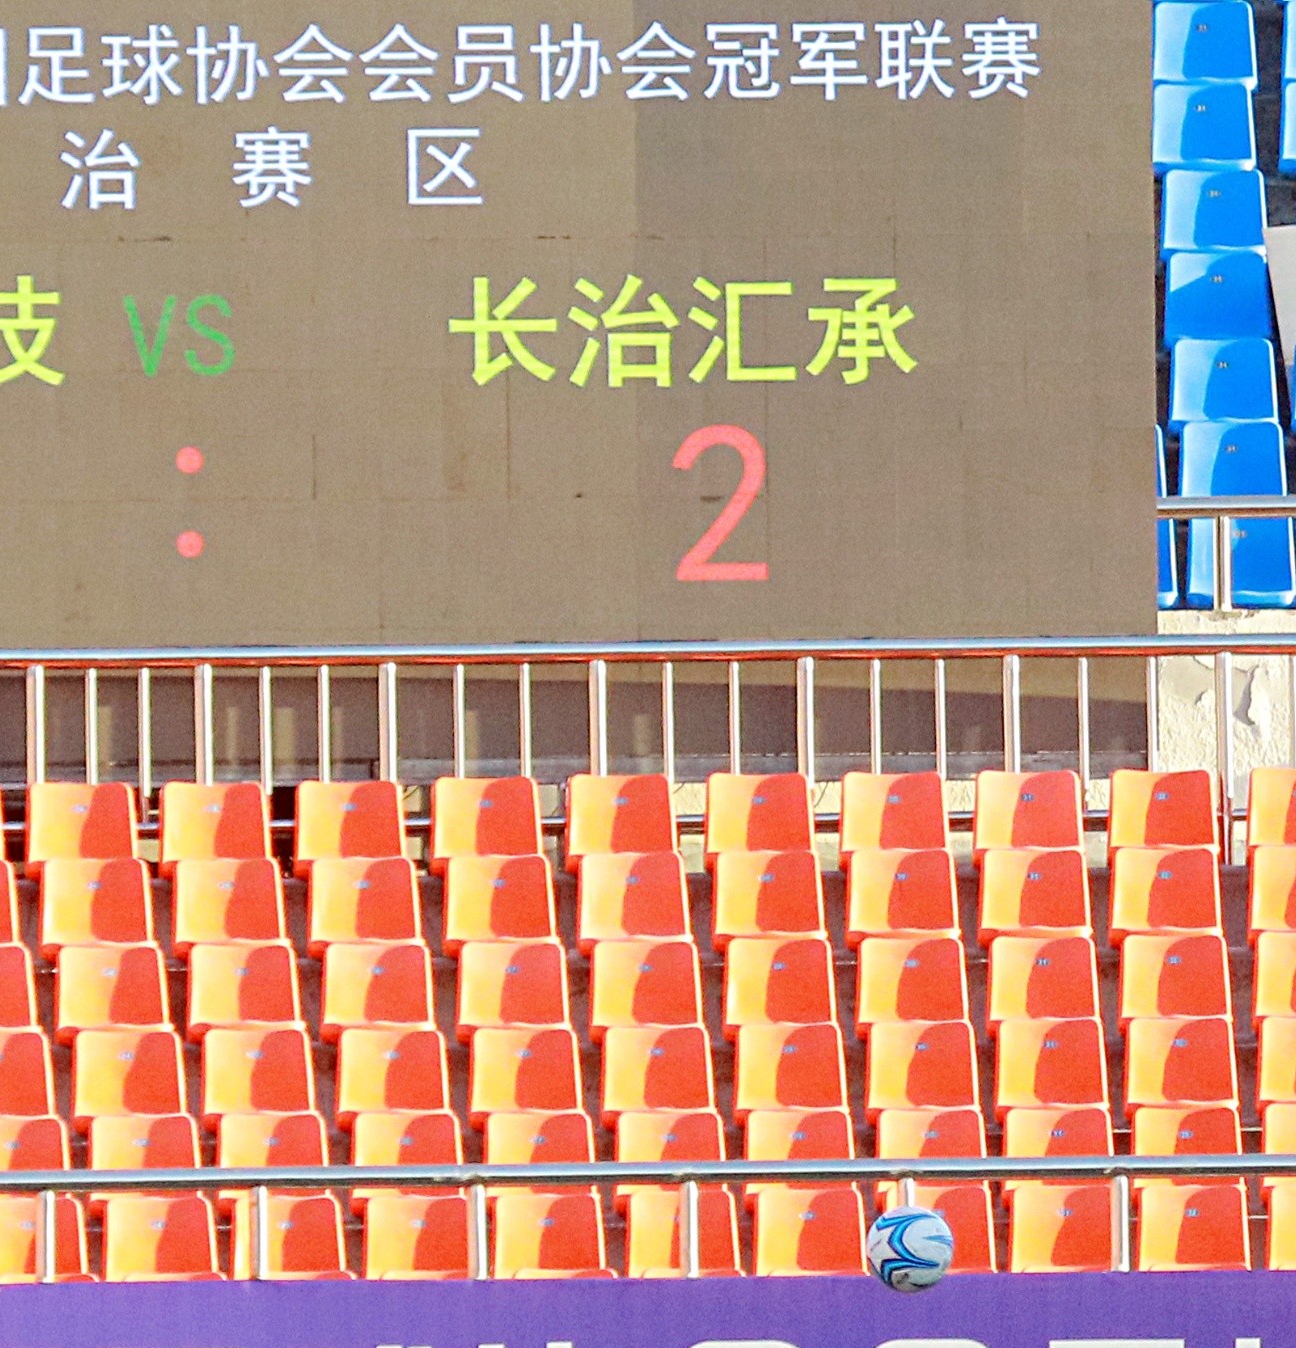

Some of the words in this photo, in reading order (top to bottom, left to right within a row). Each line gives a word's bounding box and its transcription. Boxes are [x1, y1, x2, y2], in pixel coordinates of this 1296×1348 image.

[123, 294, 236, 377] VS
[448, 273, 918, 388] 长治汇承
[672, 423, 770, 582] 2
